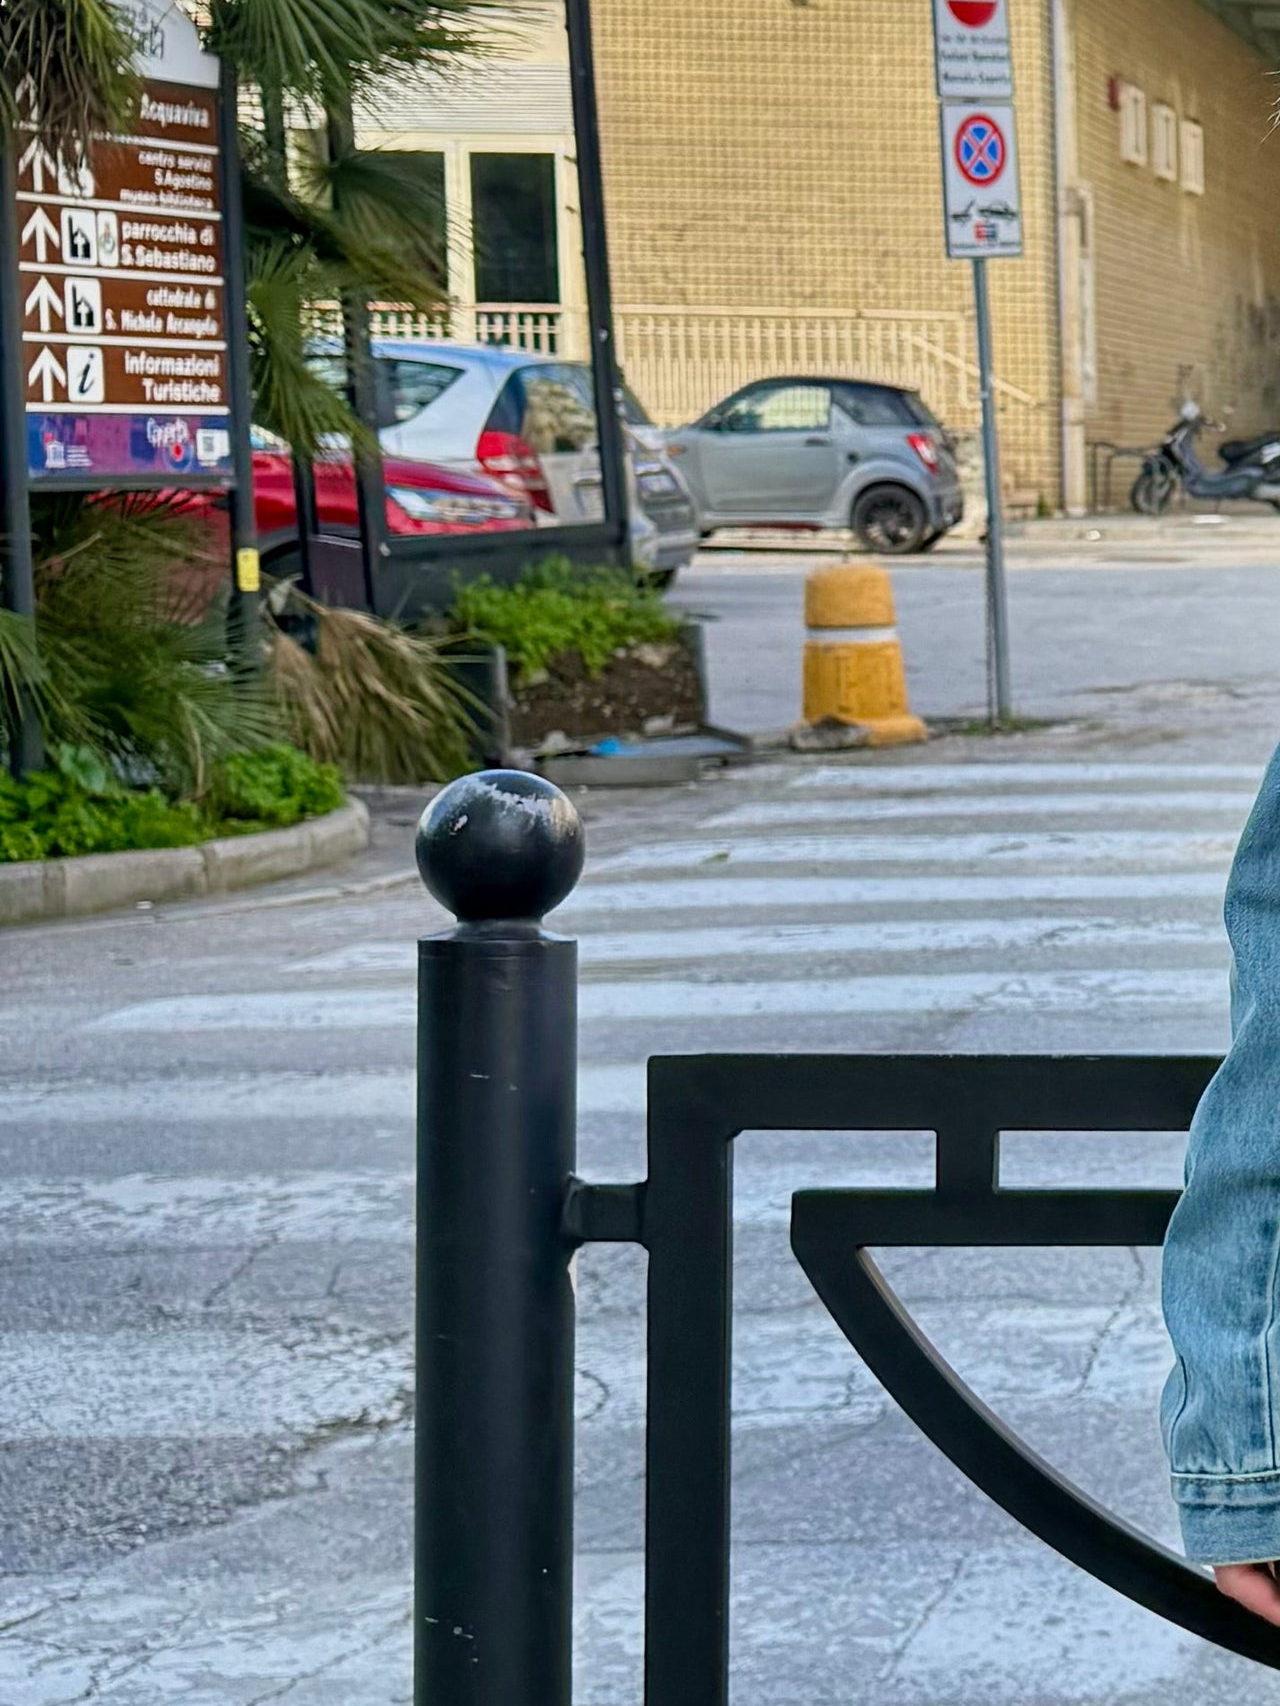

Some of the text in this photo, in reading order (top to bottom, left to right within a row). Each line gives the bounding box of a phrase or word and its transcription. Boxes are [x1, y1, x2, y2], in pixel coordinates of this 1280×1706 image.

[140, 93, 208, 128] Acquaviva
[122, 221, 214, 246] parrocchia di
[121, 309, 163, 333] Michele
[166, 311, 218, 339] Arcangelo
[141, 377, 221, 403] Turistiche
